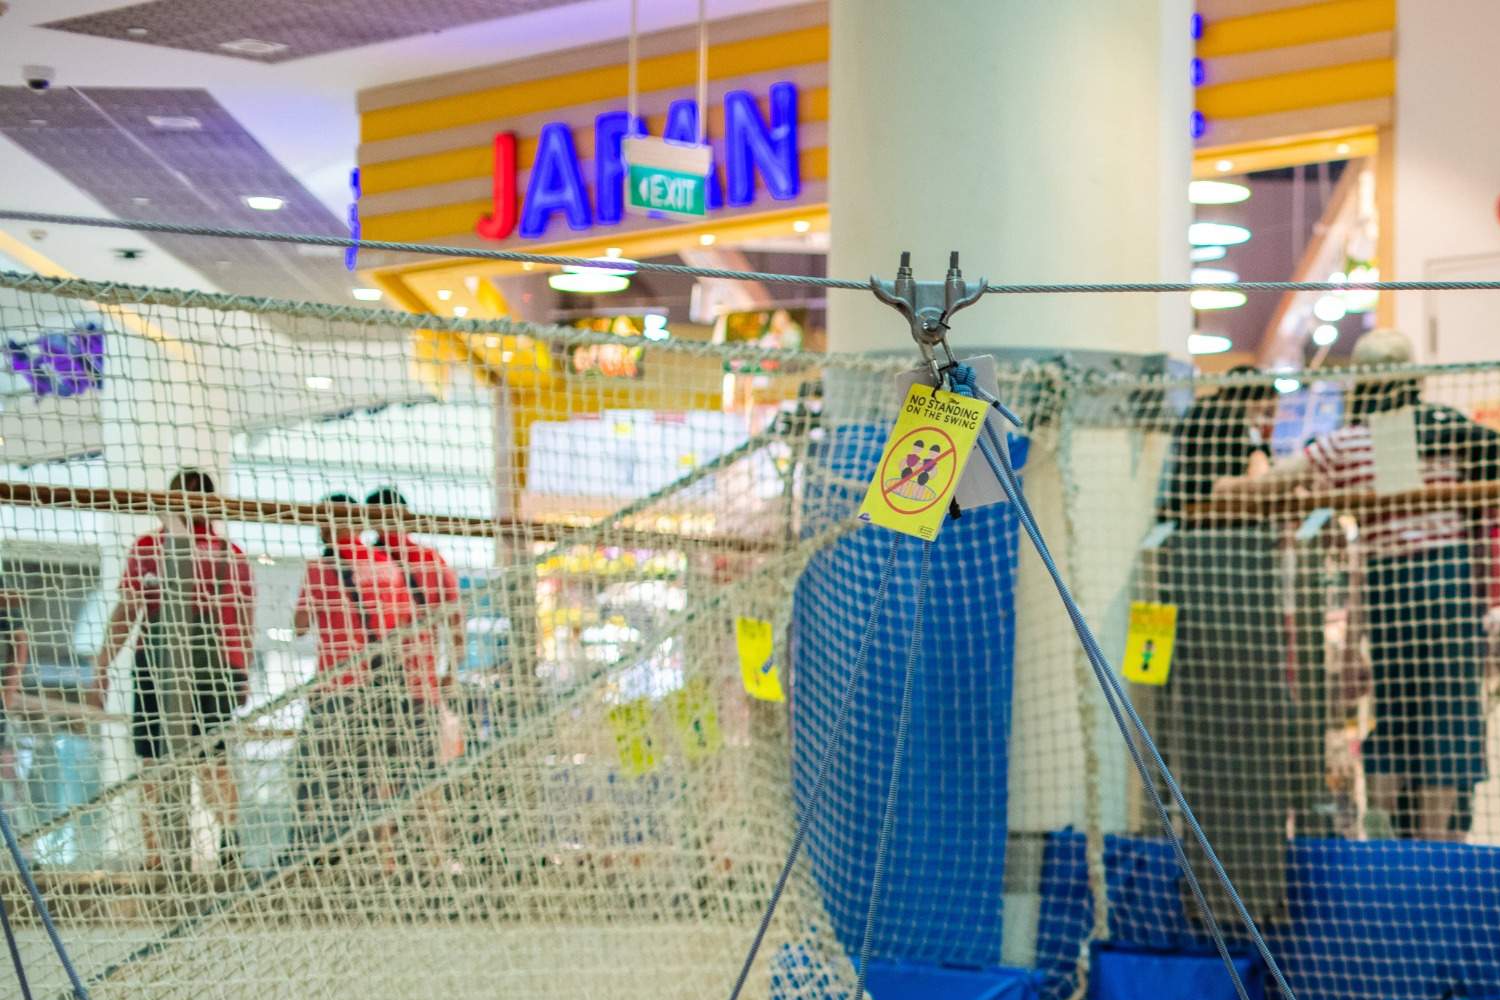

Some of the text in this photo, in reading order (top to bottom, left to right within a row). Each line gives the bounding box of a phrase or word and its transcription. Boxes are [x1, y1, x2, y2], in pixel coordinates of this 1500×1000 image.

[650, 174, 697, 210] EXIT
[906, 405, 976, 430] ON THE SWING
[910, 394, 979, 420] NO STANDING
